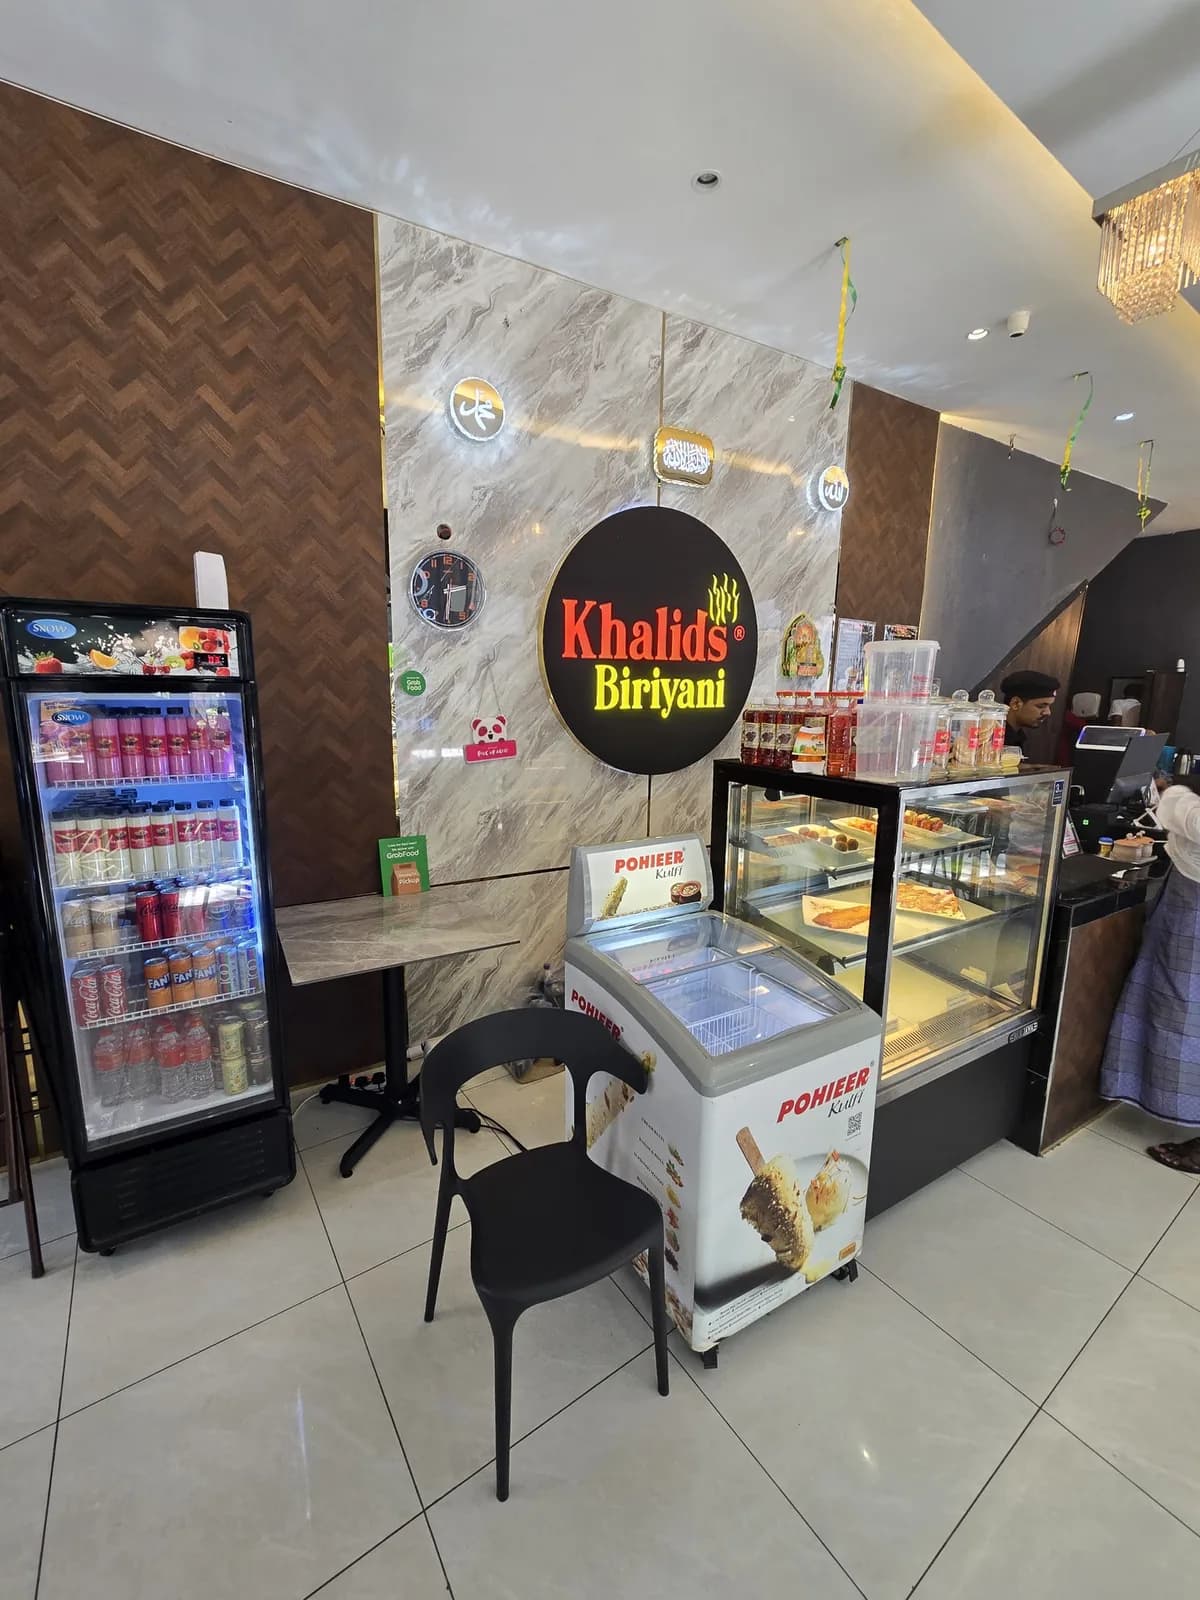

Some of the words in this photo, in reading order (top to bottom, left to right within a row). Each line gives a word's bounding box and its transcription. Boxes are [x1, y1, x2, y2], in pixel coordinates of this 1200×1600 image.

[32, 623, 68, 633] SNOW
[562, 599, 728, 662] Khalids
[594, 664, 726, 719] Biriyani
[56, 713, 85, 721] SNOW
[386, 849, 419, 859] GrabFood
[615, 850, 685, 873] POHIEER
[655, 866, 683, 880] Kulfi
[173, 969, 193, 983] FAN
[776, 1067, 870, 1123] POHIEER
